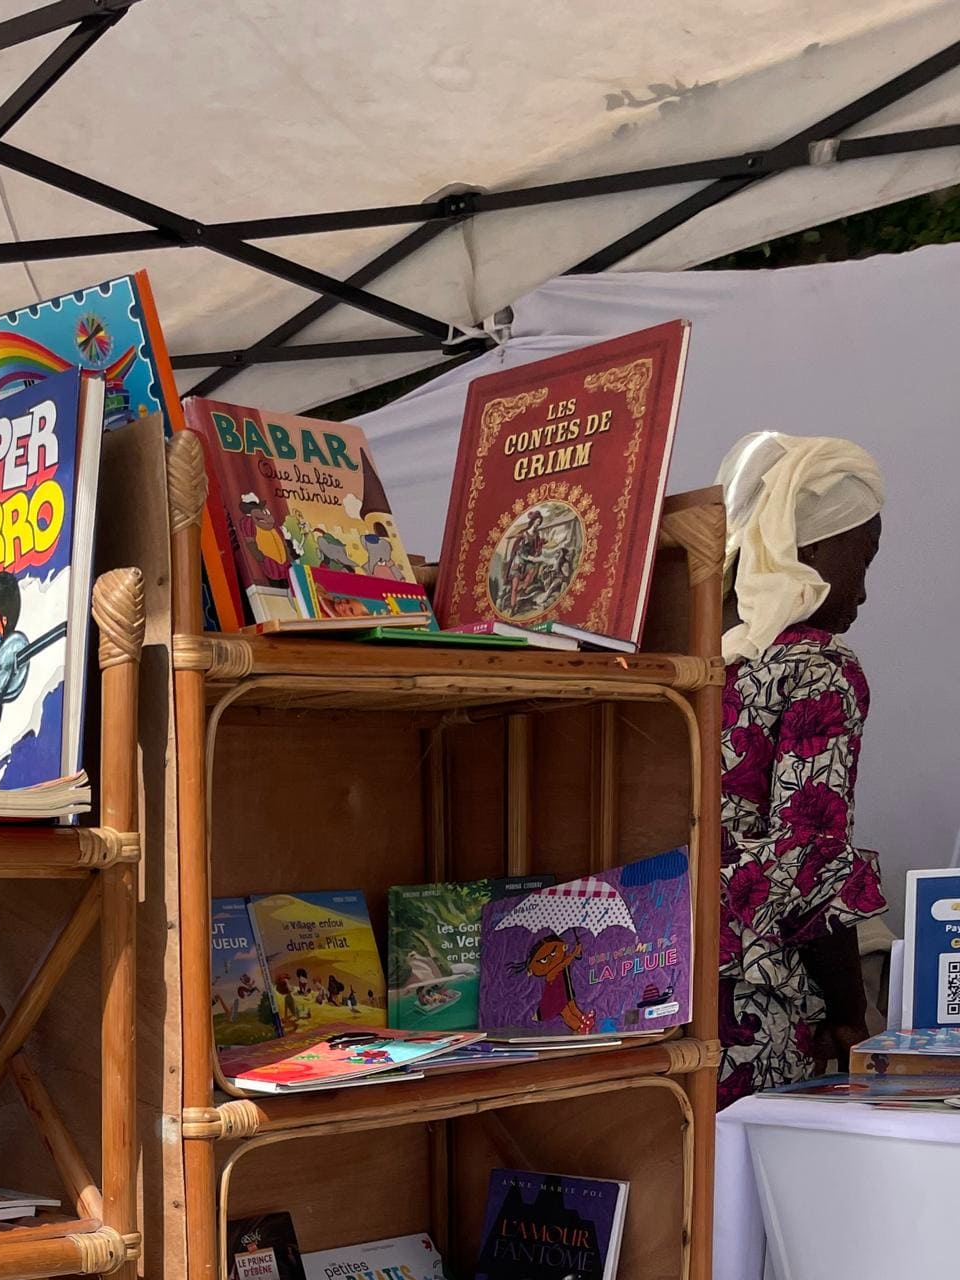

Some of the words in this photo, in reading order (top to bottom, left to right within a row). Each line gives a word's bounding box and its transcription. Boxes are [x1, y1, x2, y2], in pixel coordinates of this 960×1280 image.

[547, 399, 577, 423] LES
[211, 411, 360, 473] BABAR
[504, 418, 579, 458] CONTES
[583, 409, 612, 436] DE
[258, 460, 291, 483] Que
[294, 464, 312, 485] la
[314, 467, 344, 492] fête
[513, 442, 593, 483] GRIMM
[274, 485, 342, 507] continue
[437, 924, 455, 934] Les
[286, 939, 315, 952] dune
[589, 965, 615, 985] LA
[621, 948, 678, 977] PLUIE
[581, 1189, 604, 1199] POL
[500, 1218, 590, 1250] L'AMOUR
[248, 1253, 273, 1267] PRINCE
[493, 1237, 596, 1273] FANTÔME
